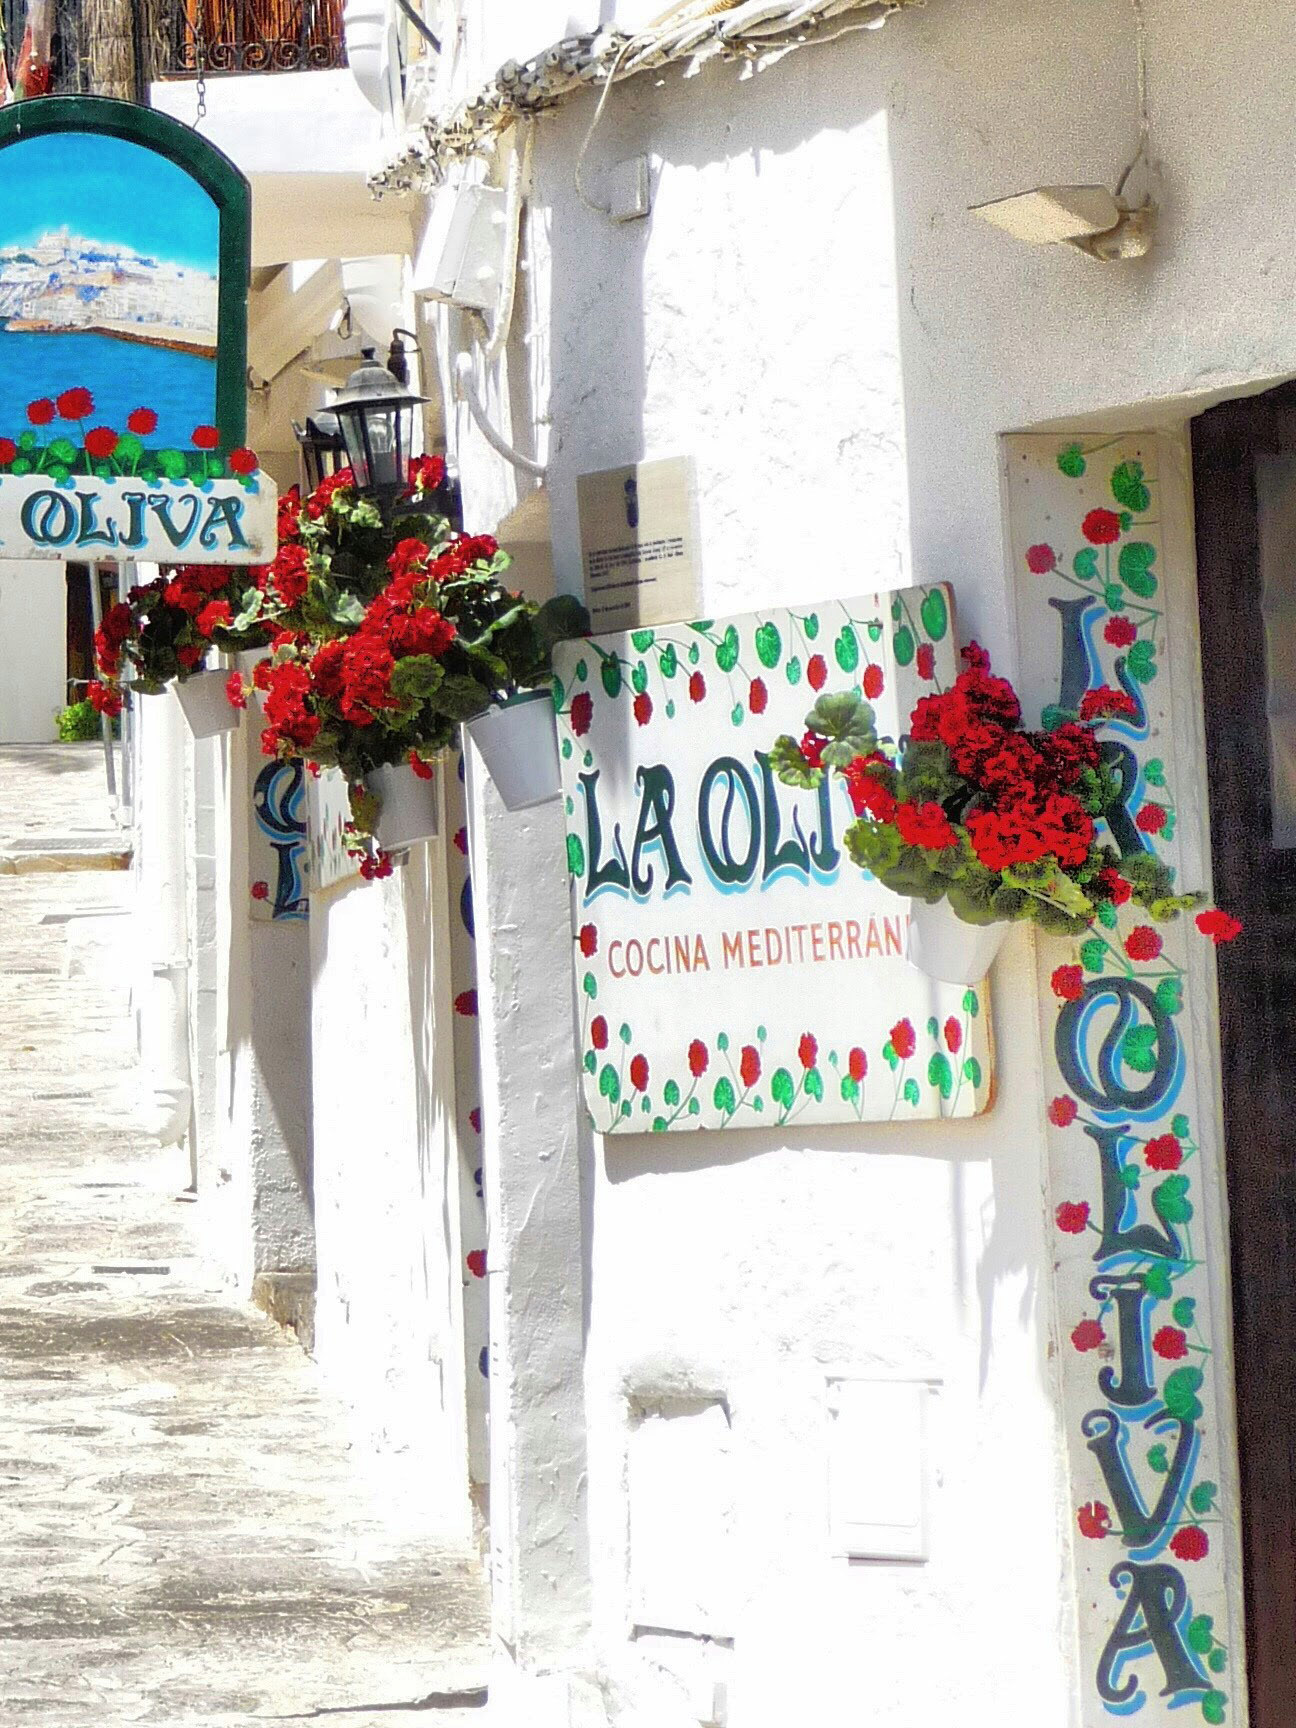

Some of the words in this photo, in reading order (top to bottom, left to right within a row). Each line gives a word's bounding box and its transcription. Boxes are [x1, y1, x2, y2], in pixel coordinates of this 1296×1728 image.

[20, 489, 252, 551] OLIVA
[579, 761, 692, 906] LA
[697, 734, 910, 896] OLI
[607, 931, 710, 979] COCINA
[722, 911, 910, 967] MEDITERRÁN
[1054, 975, 1214, 1716] OLIVA
